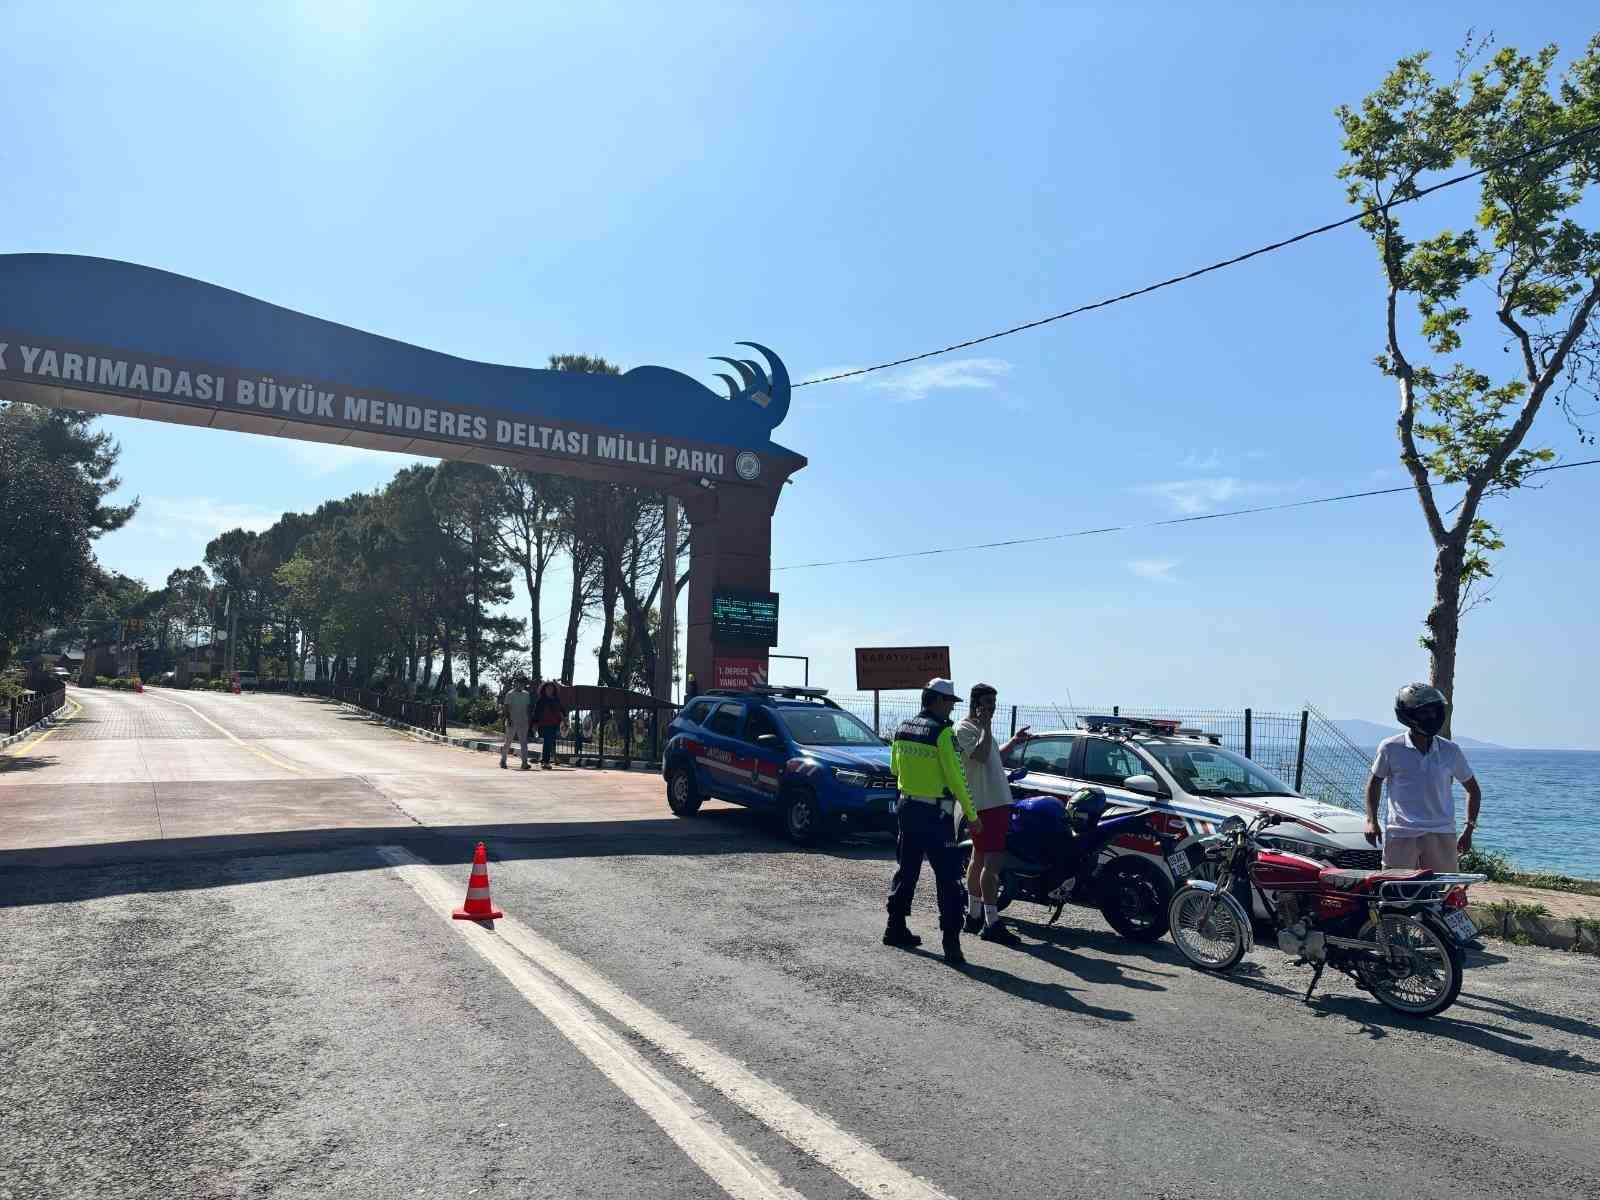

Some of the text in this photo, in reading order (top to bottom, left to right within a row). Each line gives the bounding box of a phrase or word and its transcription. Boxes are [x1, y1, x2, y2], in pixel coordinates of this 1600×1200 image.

[20, 345, 225, 401] YARIMADASI
[236, 377, 336, 417] BÜYÜK
[343, 396, 488, 441] MENDERES
[496, 419, 590, 456] DELTASI
[597, 433, 657, 465] MİLLİ
[664, 446, 725, 475] PARKI
